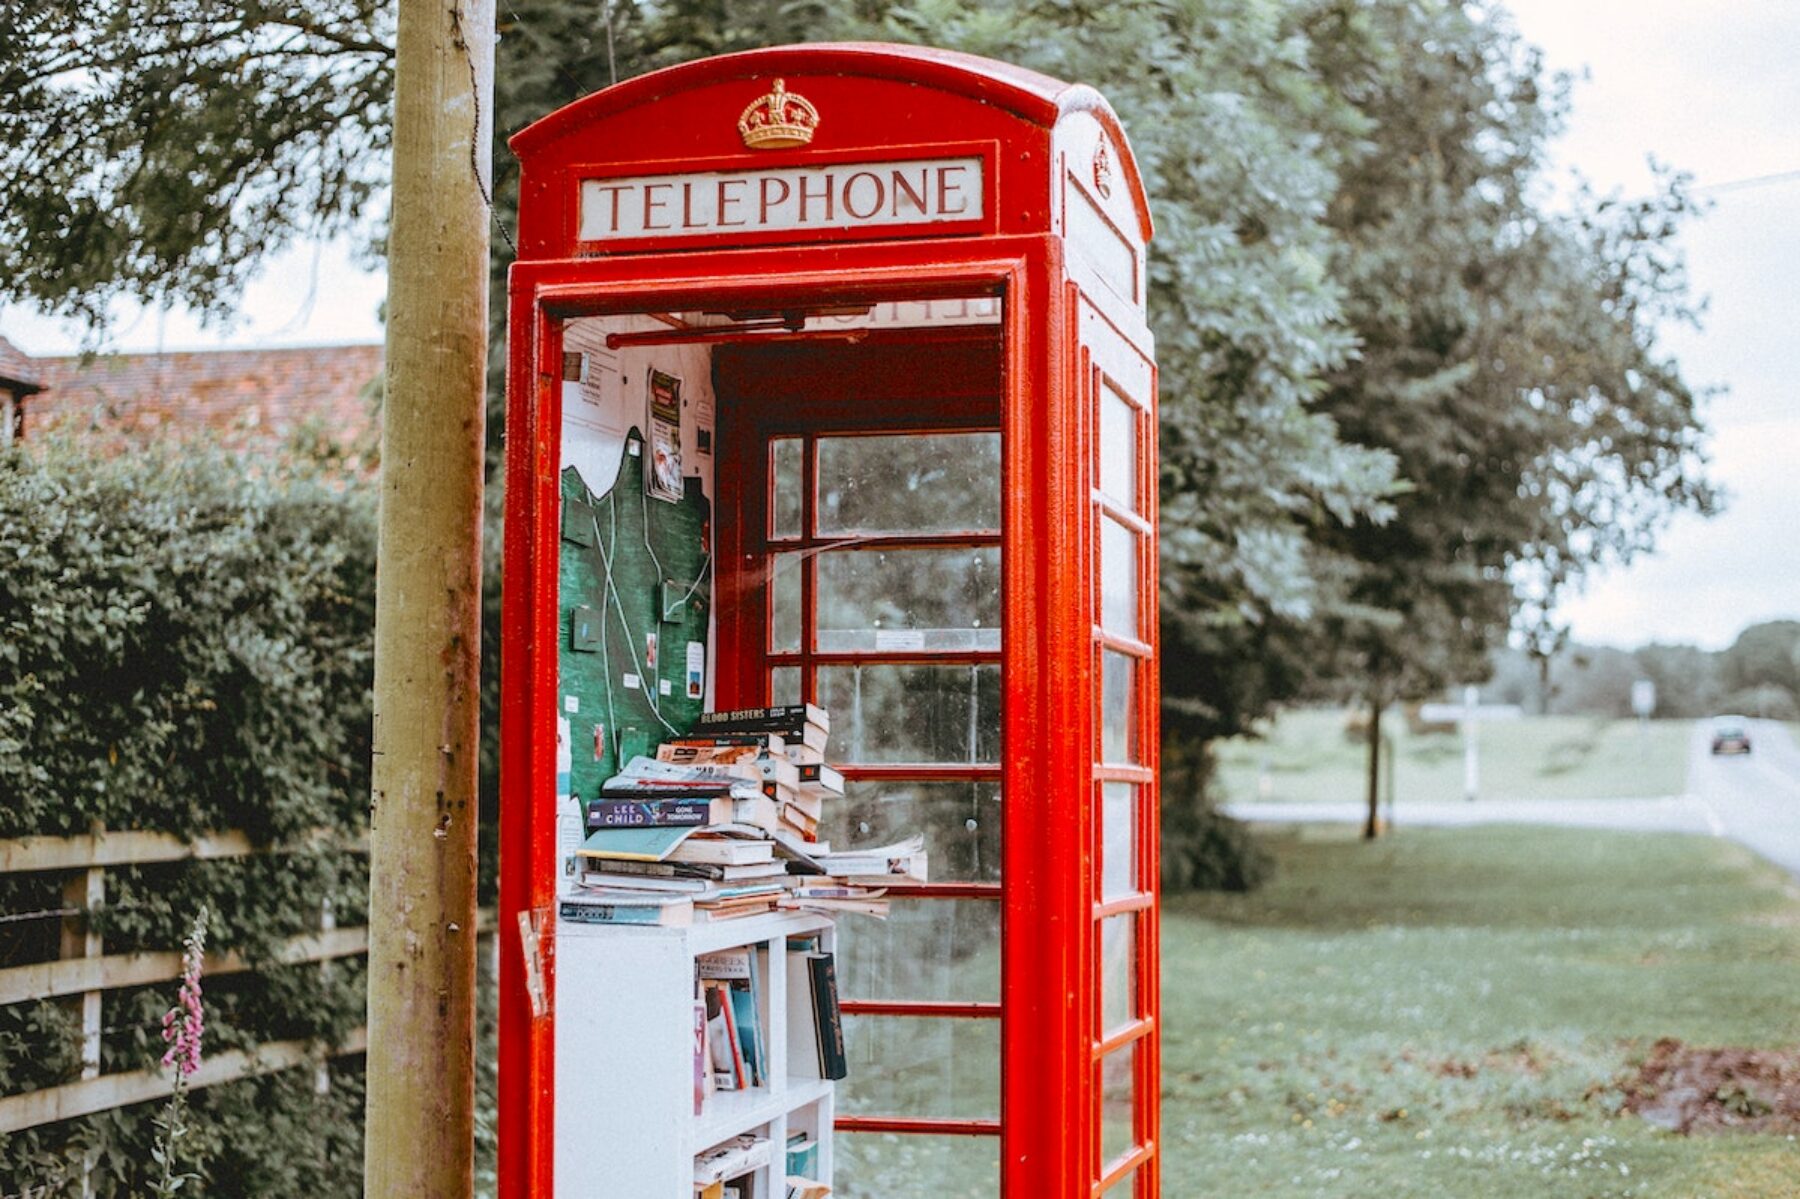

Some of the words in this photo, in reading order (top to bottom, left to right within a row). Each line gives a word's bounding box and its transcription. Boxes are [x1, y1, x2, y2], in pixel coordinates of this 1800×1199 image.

[599, 167, 966, 231] TELEPHONE
[701, 712, 729, 724] BLOOD
[730, 709, 765, 722] SISTERS
[614, 805, 636, 814] LEE
[606, 814, 644, 824] CHILD
